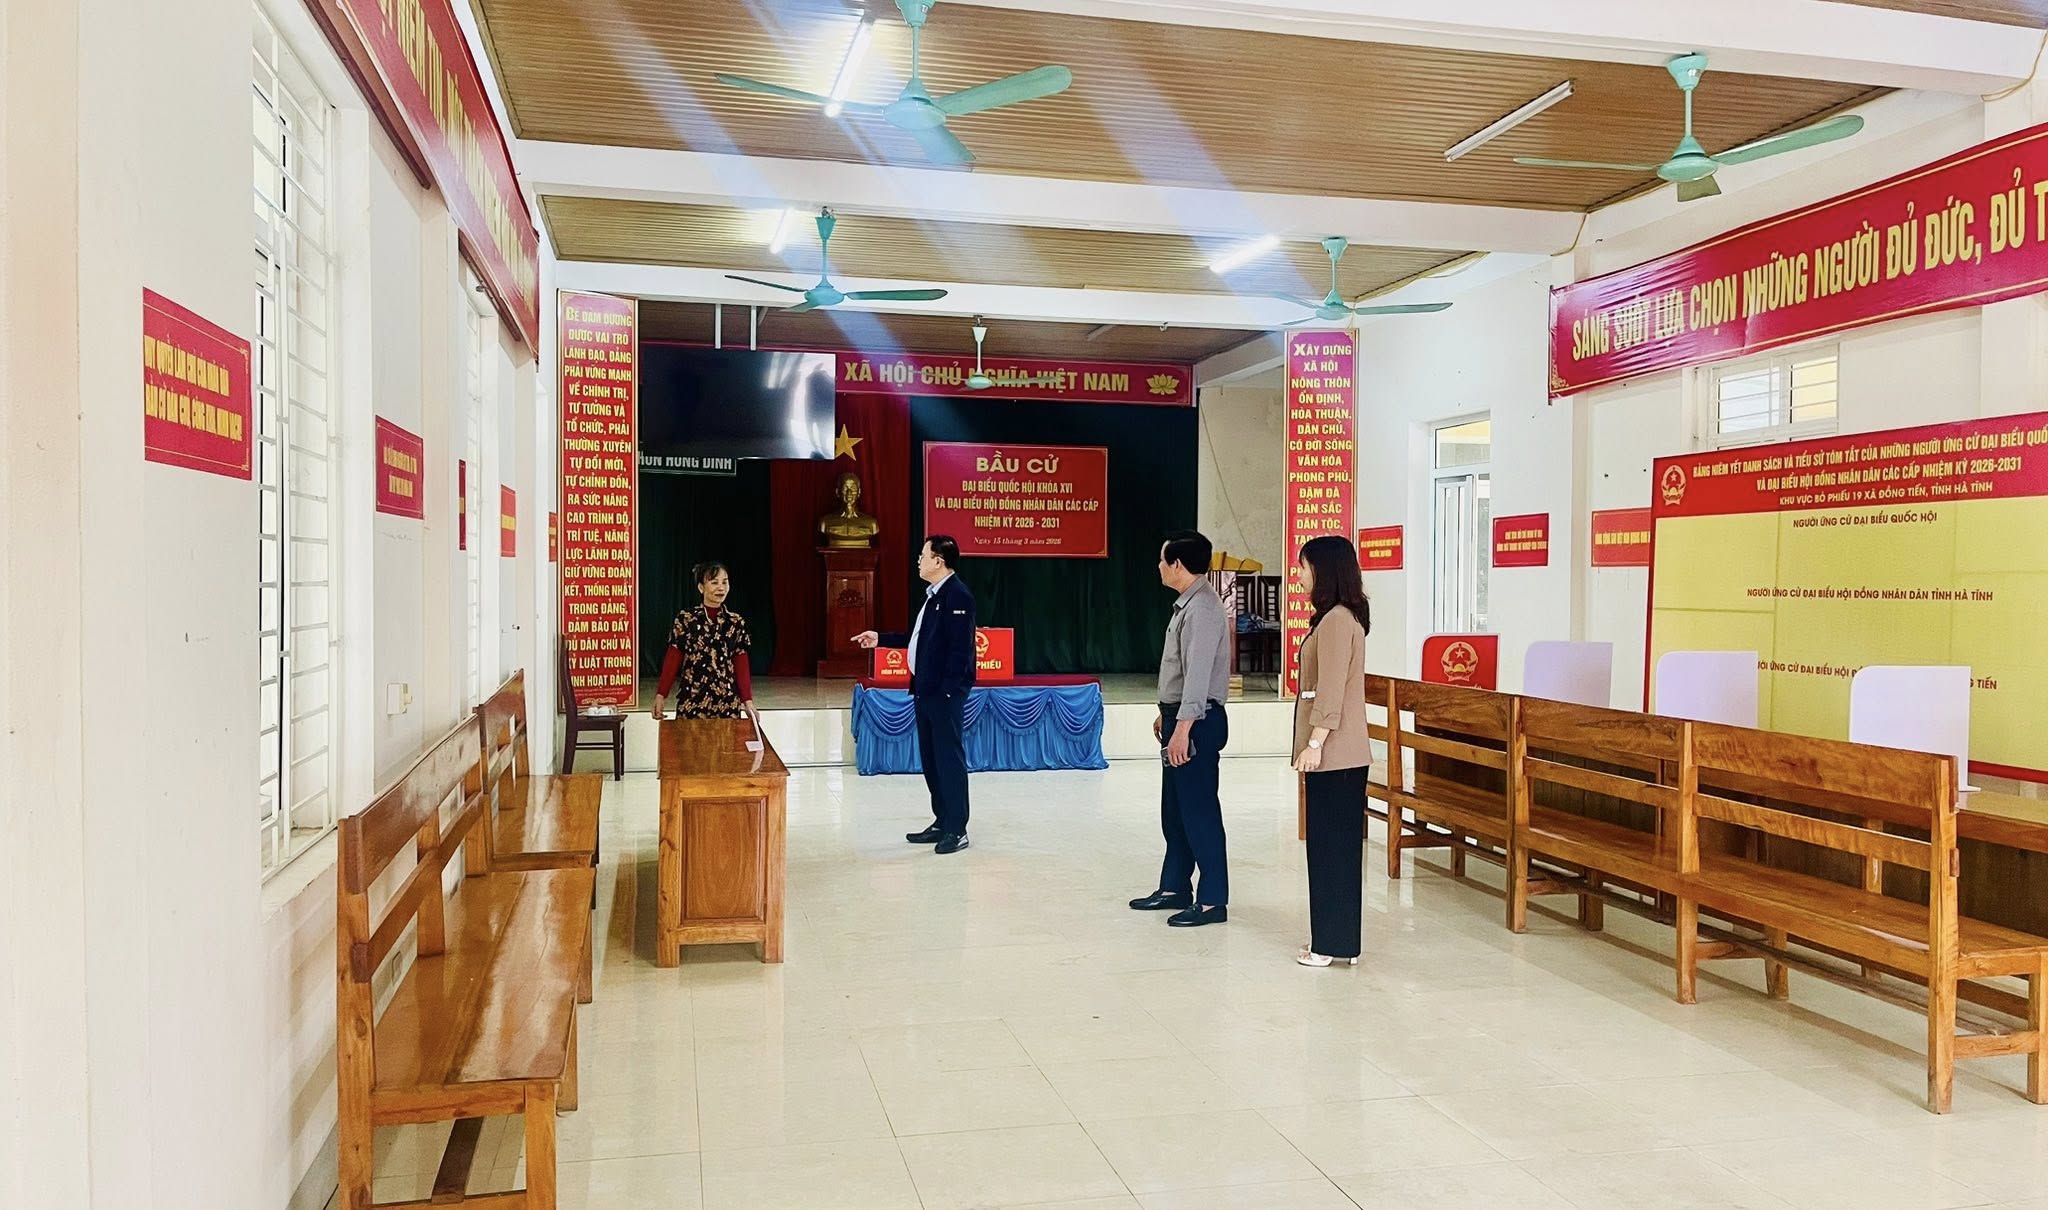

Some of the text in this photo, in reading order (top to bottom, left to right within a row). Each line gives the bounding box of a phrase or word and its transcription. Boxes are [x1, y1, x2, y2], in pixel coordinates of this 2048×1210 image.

[1573, 308, 1609, 361] SÁNG
[1689, 273, 1738, 336] CHỌN
[1743, 252, 1809, 318] NHỮNG
[1813, 220, 1879, 298] NGƯỜI
[1886, 201, 1917, 280] ĐỦ
[1924, 195, 1982, 269] ĐỨC,
[1990, 167, 2025, 254] ĐỦ
[595, 331, 610, 344] VAI
[1294, 343, 1352, 357] XÂY DỰNG
[564, 361, 583, 378] PHẢI
[1303, 359, 1338, 374] XÃ HỘI
[844, 359, 1129, 394] XÃ HỘI CHỦ VIỆT NAM
[1291, 375, 1351, 388] NÔNG THÔN
[1316, 393, 1344, 406] ĐỊNH,
[613, 403, 625, 417] VÀ
[1291, 406, 1352, 421] HÒA THUẬN,
[1297, 418, 1346, 435] DÂN CHỦ,
[602, 440, 632, 453] XUYÊN
[1289, 436, 1352, 451] CÓ ĐỜI SỐNG
[1692, 463, 1711, 478] BẢNG
[1729, 458, 1742, 474] YẾT
[1742, 459, 1762, 473] DANH
[1763, 457, 1783, 471] SÁCH
[1784, 454, 1794, 469] VÀ
[1795, 450, 1812, 468] TIỂU
[1813, 450, 1825, 465] SỬ
[1826, 449, 1843, 465] TÓM
[1845, 445, 1859, 463] TẮT
[1861, 443, 1878, 461] CỦA
[1879, 441, 1911, 460] NHỮNG
[1912, 437, 1941, 456] NGƯỜI
[1943, 435, 1963, 453] ỨNG
[1965, 431, 1981, 451] CỬ
[1981, 433, 1998, 452] ĐẠI
[2000, 426, 2024, 448] BIỂU
[976, 450, 1059, 474] BẦU CỬ
[1297, 454, 1342, 467] VĂN HÓA
[579, 471, 607, 489] CHỈNH
[1289, 472, 1325, 483] PHONG
[1756, 456, 2022, 493] VÀ ĐẠI BIỂU HỘI ĐỒNG NHÂN DÂN CÁC CẤP NHIỆM KỲ 2026-2031
[962, 476, 1073, 496] ĐẠI BIỂU QUỐC HỘI KHÓA XVI
[1299, 485, 1340, 500] ĐẬM ĐÀ
[1779, 480, 1993, 507] KHU VỰC BỎ PHIẾU 19 XÃ ĐỒNG TIẾN, TỈNH HÀ TĨNH
[567, 491, 601, 506] RA SỨC
[934, 494, 1099, 513] VÀ ĐẠI BIỂU HỘI ĐỒNG NHÂN DÂN CÁC CẤP
[1296, 499, 1342, 514] BẢN SẮC
[566, 509, 614, 524] CAO TRÌNH
[974, 514, 1001, 530] NHIỆM
[1015, 516, 1034, 528] 2026
[1041, 517, 1060, 528] 2031
[1296, 517, 1344, 531] DÂN TỘC,
[1793, 510, 1938, 528] NGƯỜI ỨNG CỬ ĐẠI BIỂU QUỐC HỘI
[973, 537, 991, 545] Ngày
[1023, 537, 1029, 545] 3
[1747, 585, 1993, 601] NGƯỜI ỨNG CỬ ĐẠI BIỂU HỘI ĐỒNG NHÂN DÂN TỈNH HÀ TĨNH
[569, 603, 598, 615] TRONG
[1289, 598, 1301, 611] VÀ
[568, 616, 609, 632] ĐẢM BẢO
[1287, 616, 1310, 629] NÔNG
[580, 633, 632, 651] DÂN CHỦ VÀ
[579, 655, 632, 671] LUẬT TRONG
[587, 669, 632, 688] HOẠT ĐẢNG
[1769, 660, 1786, 672] ỨNG
[1787, 661, 1799, 673] CỬ
[1800, 664, 1815, 677] ĐẠI
[1815, 662, 1833, 676] BIỂU
[1834, 665, 1850, 680] HỘI
[1977, 675, 1997, 690] TIẾN
